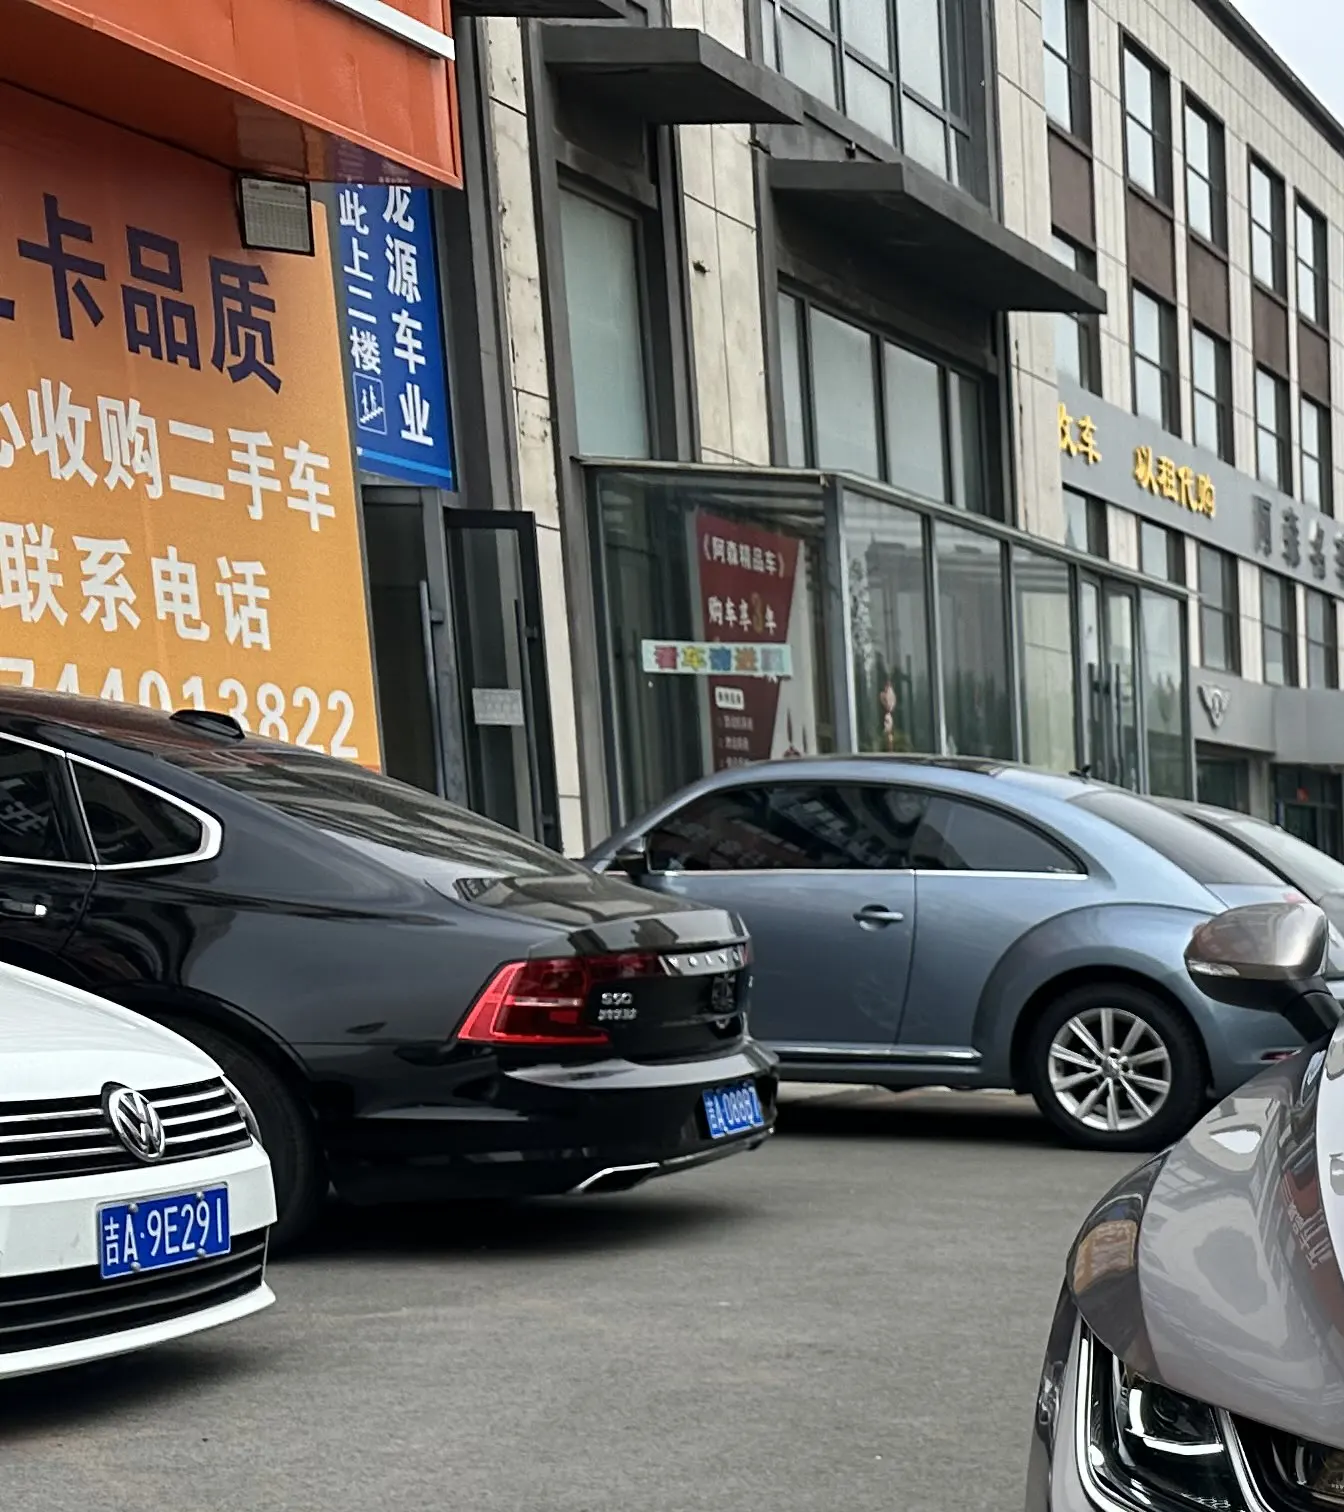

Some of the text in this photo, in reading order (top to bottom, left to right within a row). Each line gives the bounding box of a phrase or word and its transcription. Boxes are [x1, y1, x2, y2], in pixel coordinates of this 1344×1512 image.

[0, 192, 282, 394] 卡品质
[340, 184, 382, 375] 此上二楼
[382, 186, 434, 447] 龙源车业
[0, 521, 271, 650] 联系电话
